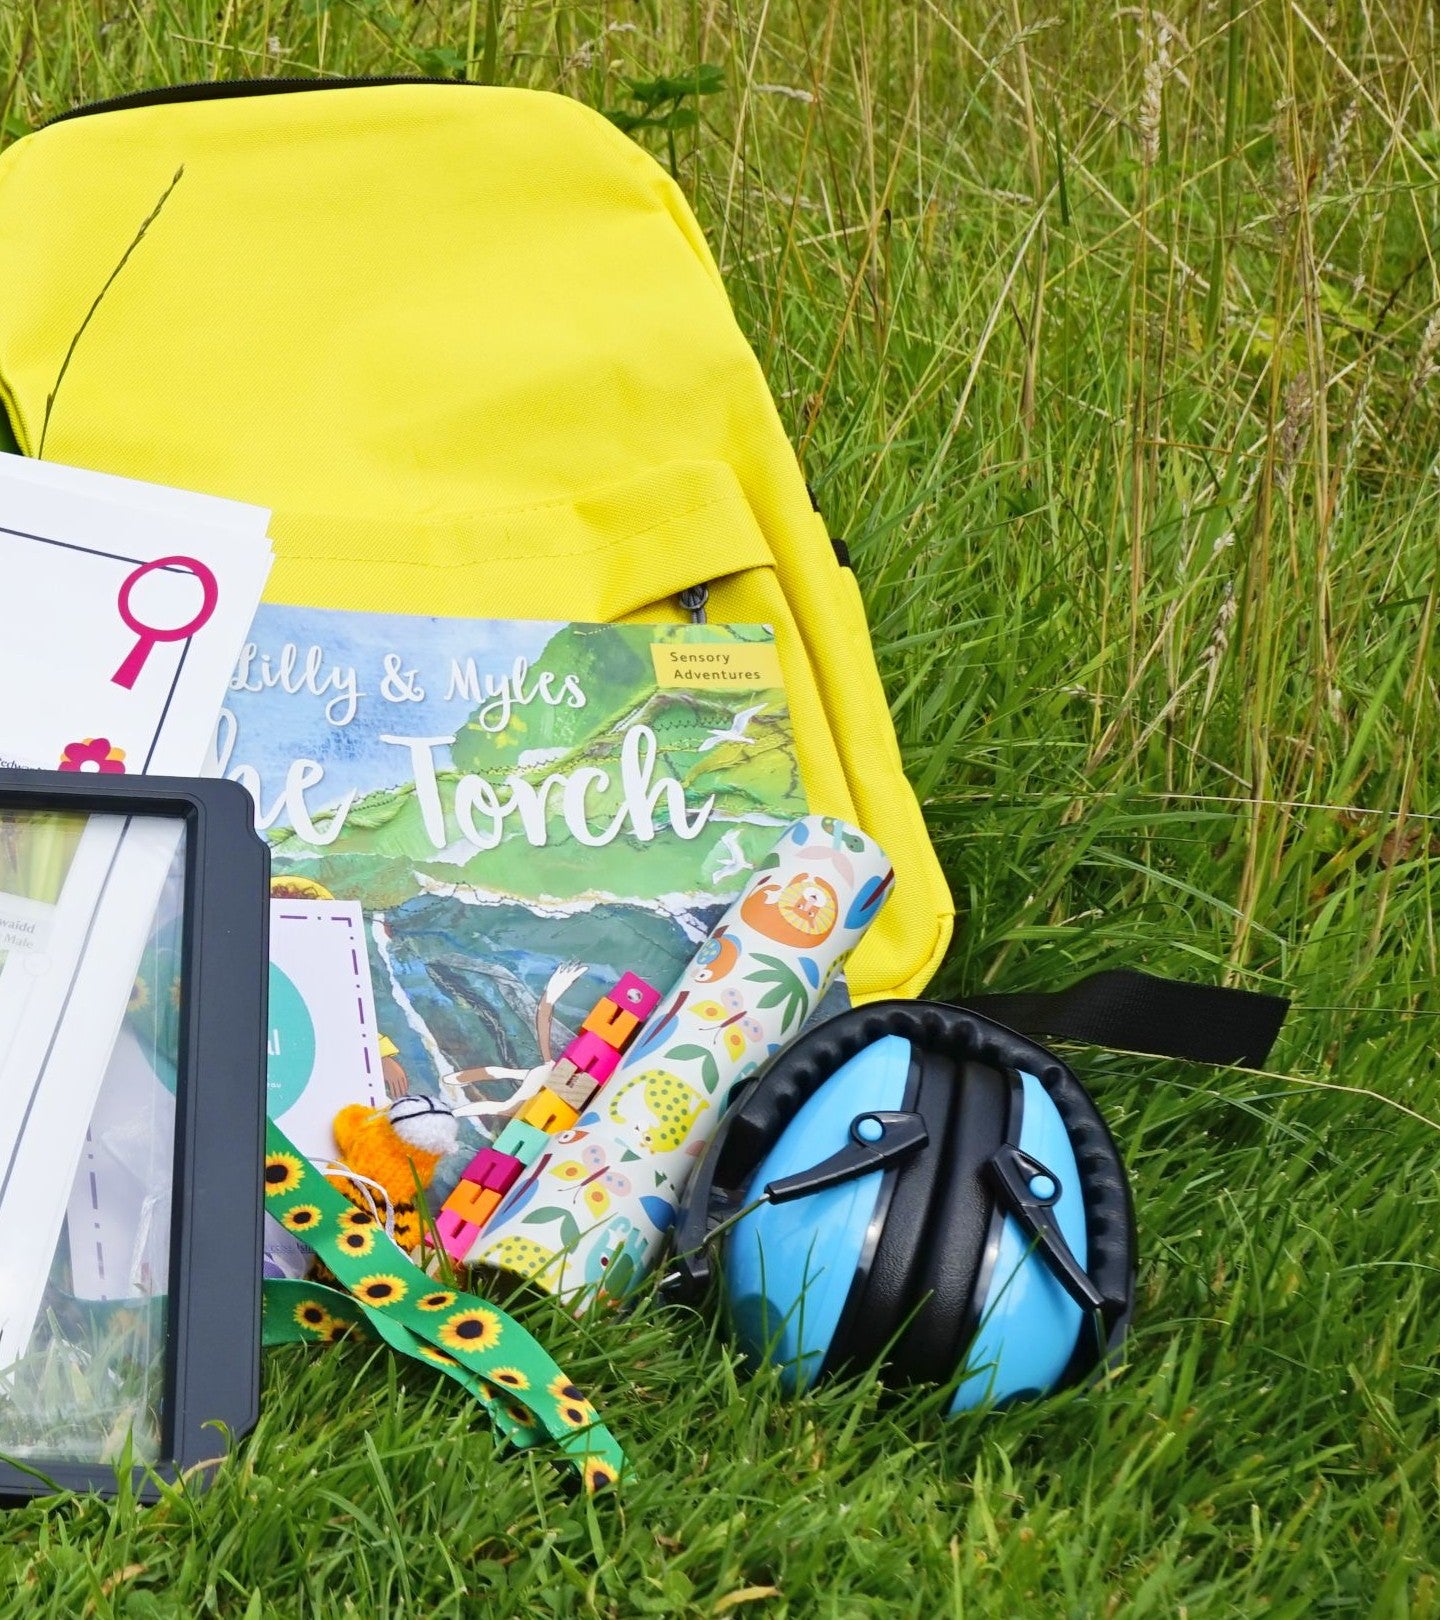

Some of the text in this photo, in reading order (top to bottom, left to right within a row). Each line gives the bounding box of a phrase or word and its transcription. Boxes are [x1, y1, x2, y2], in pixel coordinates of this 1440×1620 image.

[669, 651, 731, 666] Sensory
[673, 668, 762, 682] Adventures
[228, 642, 587, 733] Lilly & Myles
[212, 707, 715, 850] he Torch
